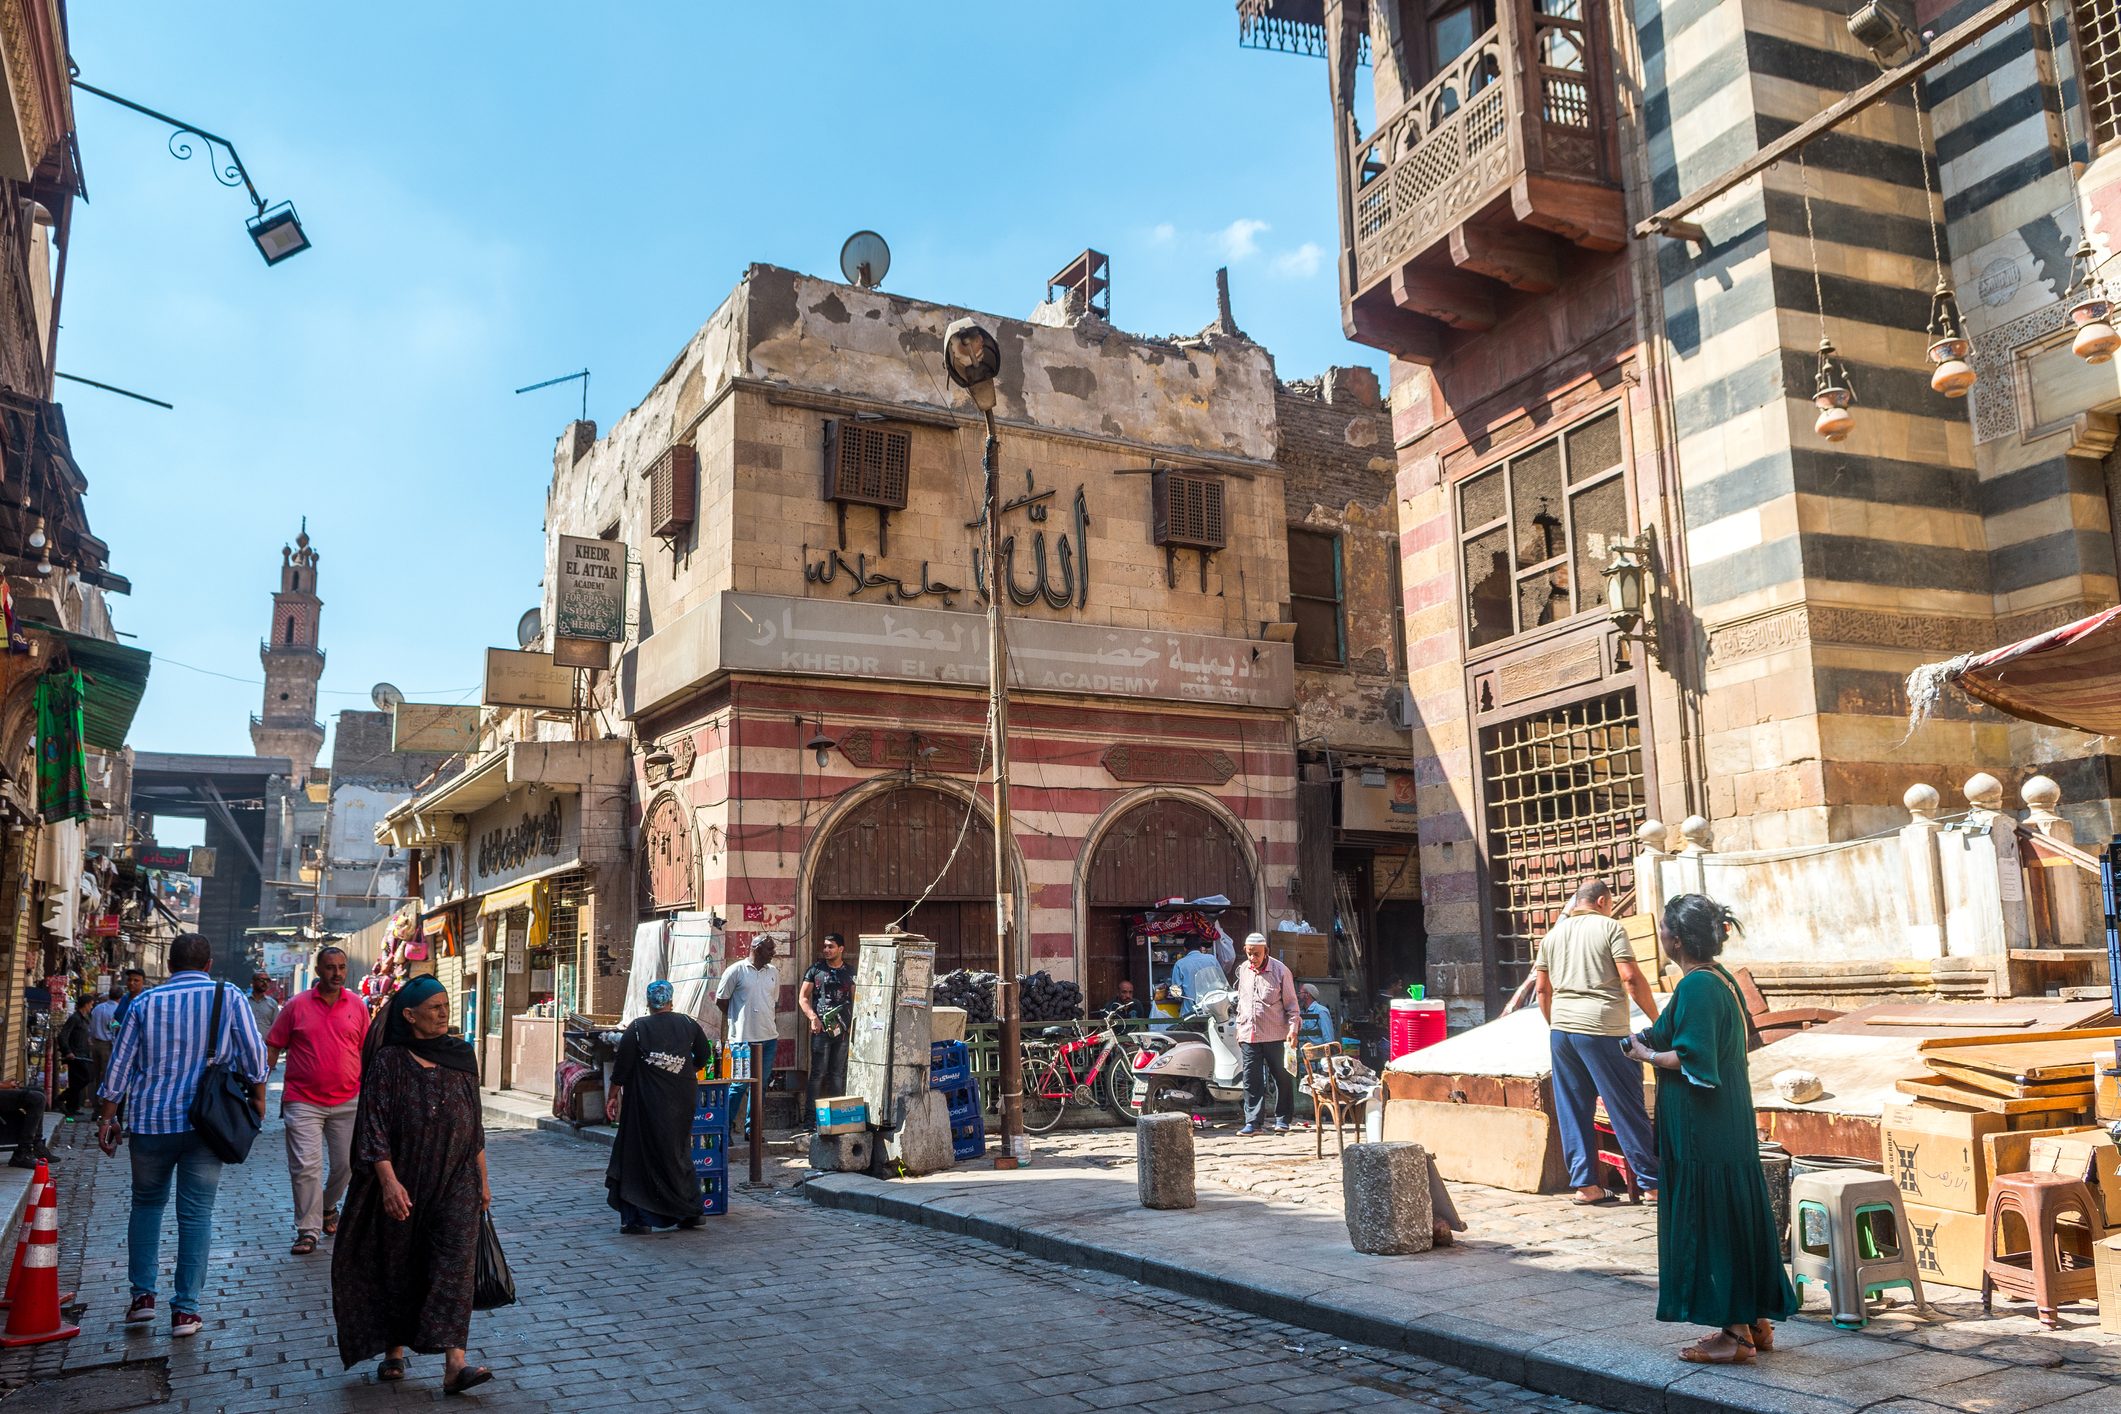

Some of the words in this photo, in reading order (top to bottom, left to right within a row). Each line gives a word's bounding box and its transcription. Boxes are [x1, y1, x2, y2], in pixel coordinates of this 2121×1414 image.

[575, 544, 610, 562] KHEDR
[566, 561, 580, 575] EL
[582, 563, 618, 580] ATTAR
[573, 579, 605, 591] ACADEMY
[565, 592, 582, 602] FOR
[583, 594, 615, 606] PLANTS
[568, 606, 610, 618] SPICES
[571, 620, 607, 631] HERBES
[745, 607, 980, 655] العطار
[781, 651, 880, 675] KHEDR
[903, 658, 935, 677] EL
[942, 663, 1025, 685] ATTR
[1041, 671, 1160, 693] ACADEMY
[950, 1106, 968, 1117] pepsi
[956, 1145, 975, 1156] pepsi
[1886, 1131, 1894, 1162] GERBER
